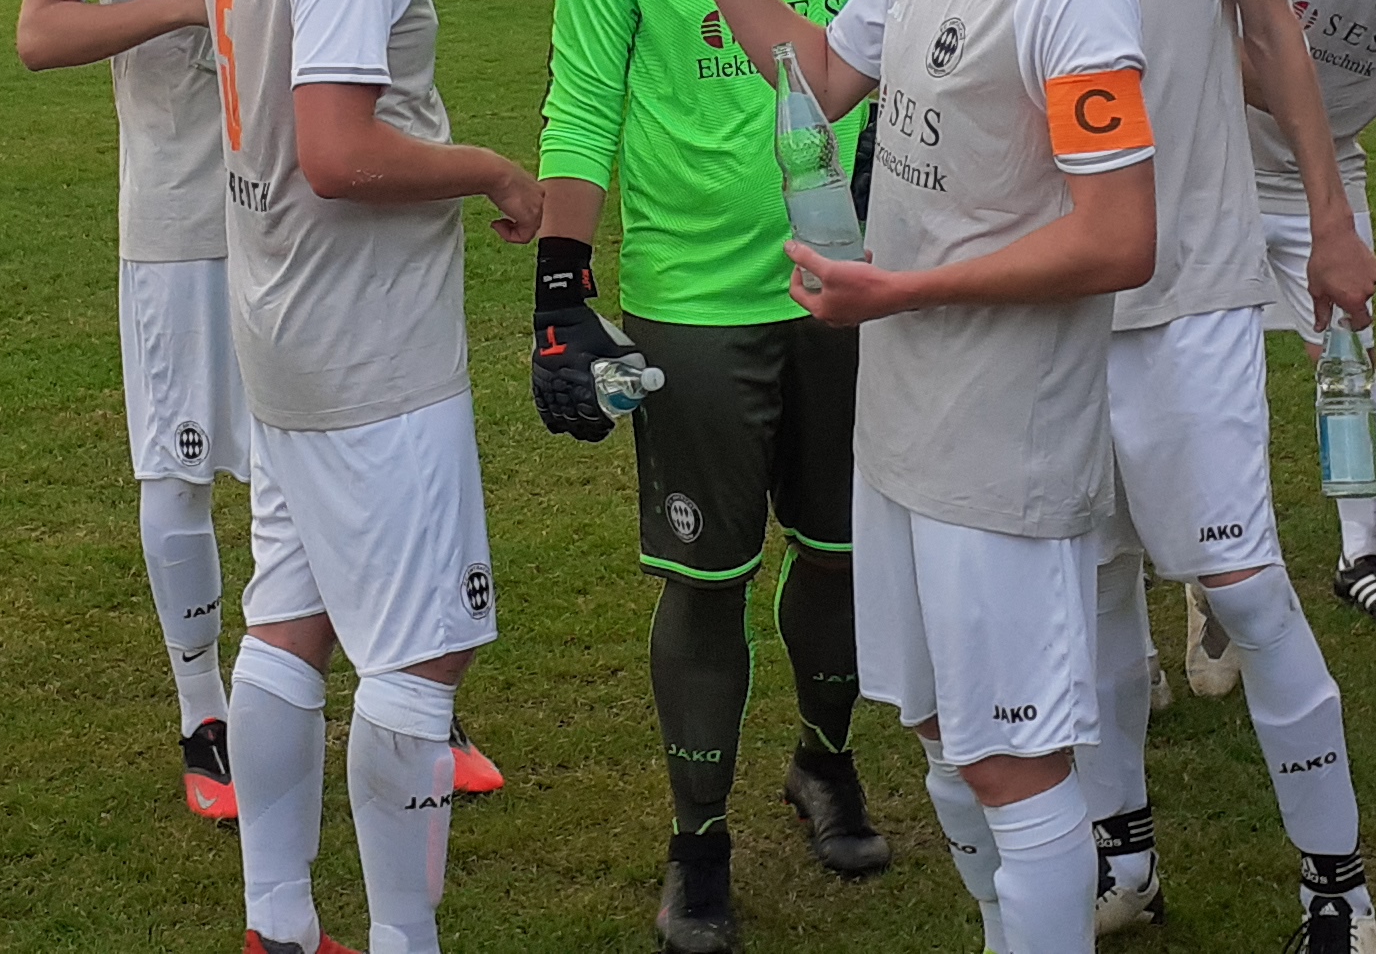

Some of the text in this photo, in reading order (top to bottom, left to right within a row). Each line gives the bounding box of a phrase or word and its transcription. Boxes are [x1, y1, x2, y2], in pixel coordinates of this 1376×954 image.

[1074, 88, 1123, 135] C
[1198, 523, 1244, 543] JAKO
[992, 704, 1039, 724] JAKO
[668, 743, 722, 764] JAKO
[1279, 751, 1338, 774] JAKO
